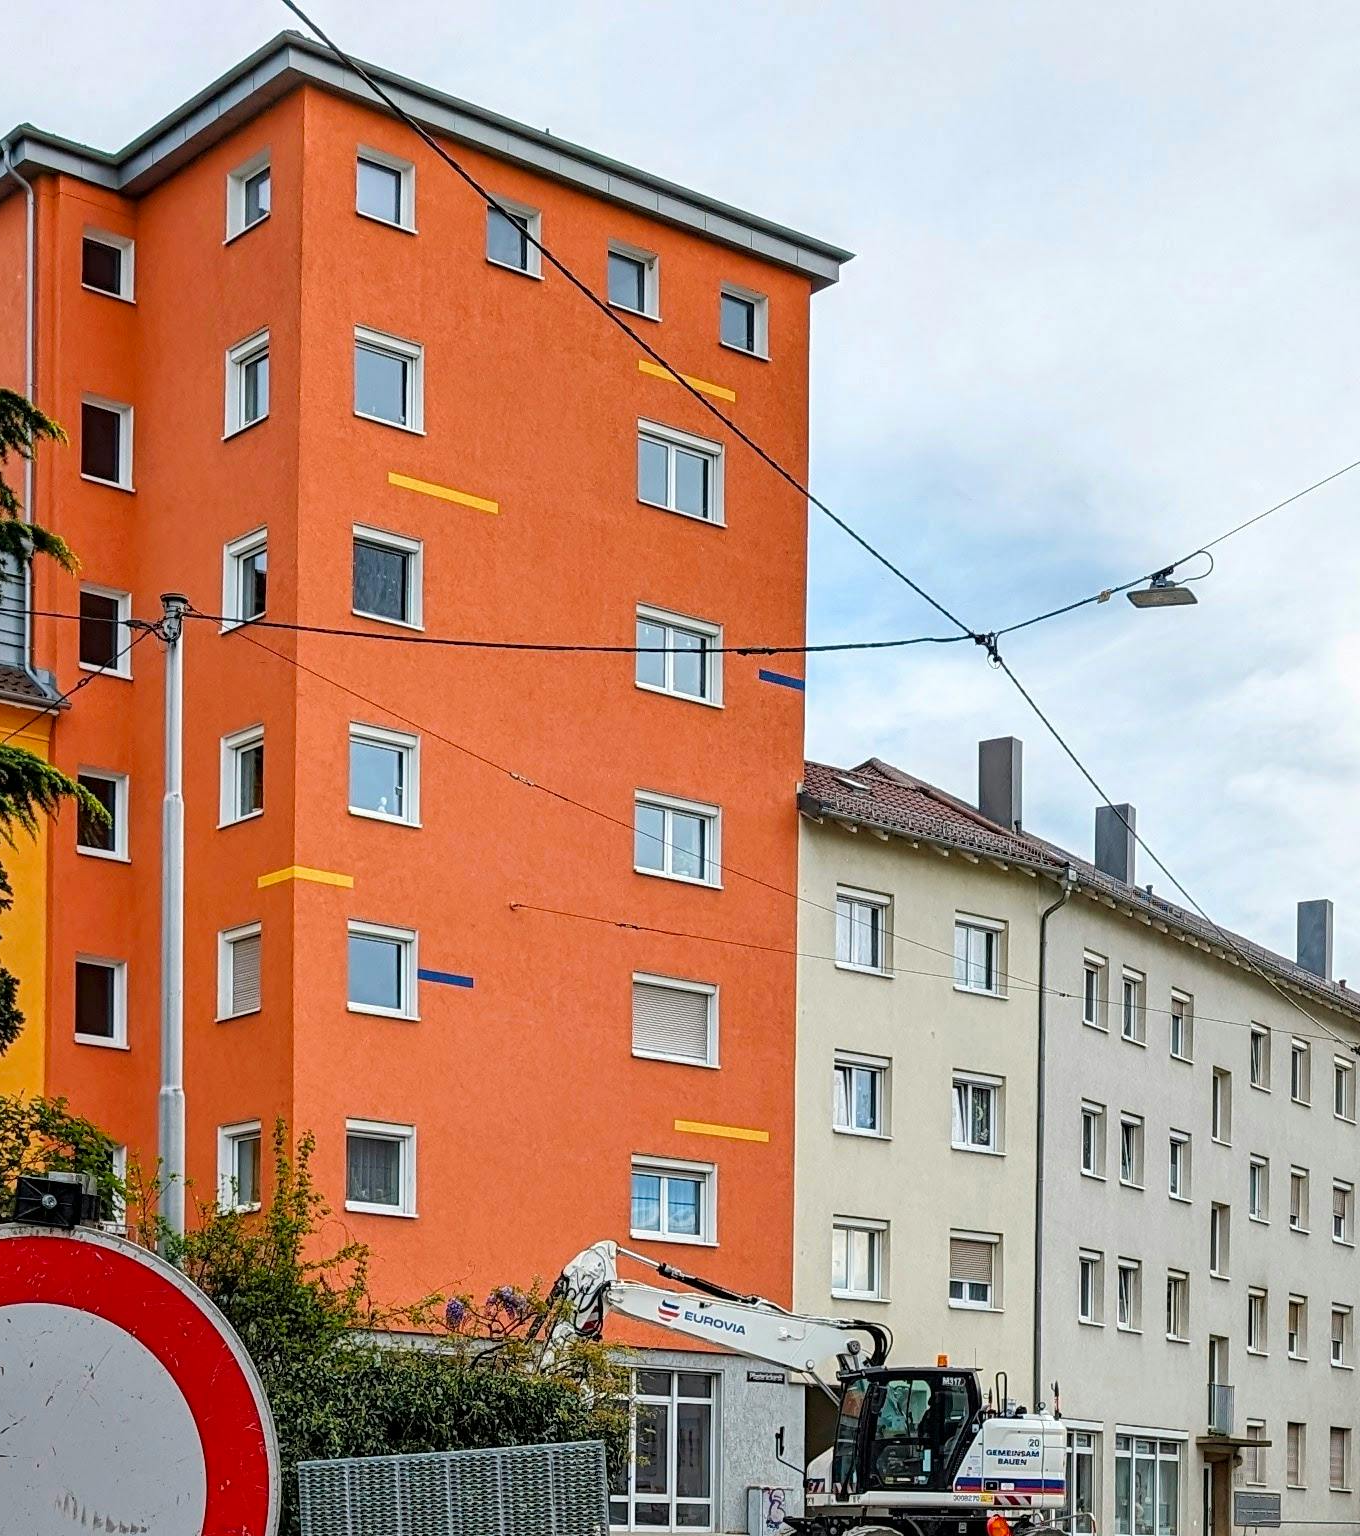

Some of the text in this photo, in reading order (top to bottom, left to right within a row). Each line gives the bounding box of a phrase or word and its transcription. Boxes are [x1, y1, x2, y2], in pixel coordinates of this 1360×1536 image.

[684, 1311, 746, 1336] EUROVIA
[985, 1449, 1040, 1458] GEMEINSAM
[997, 1458, 1028, 1466] BAUEN
